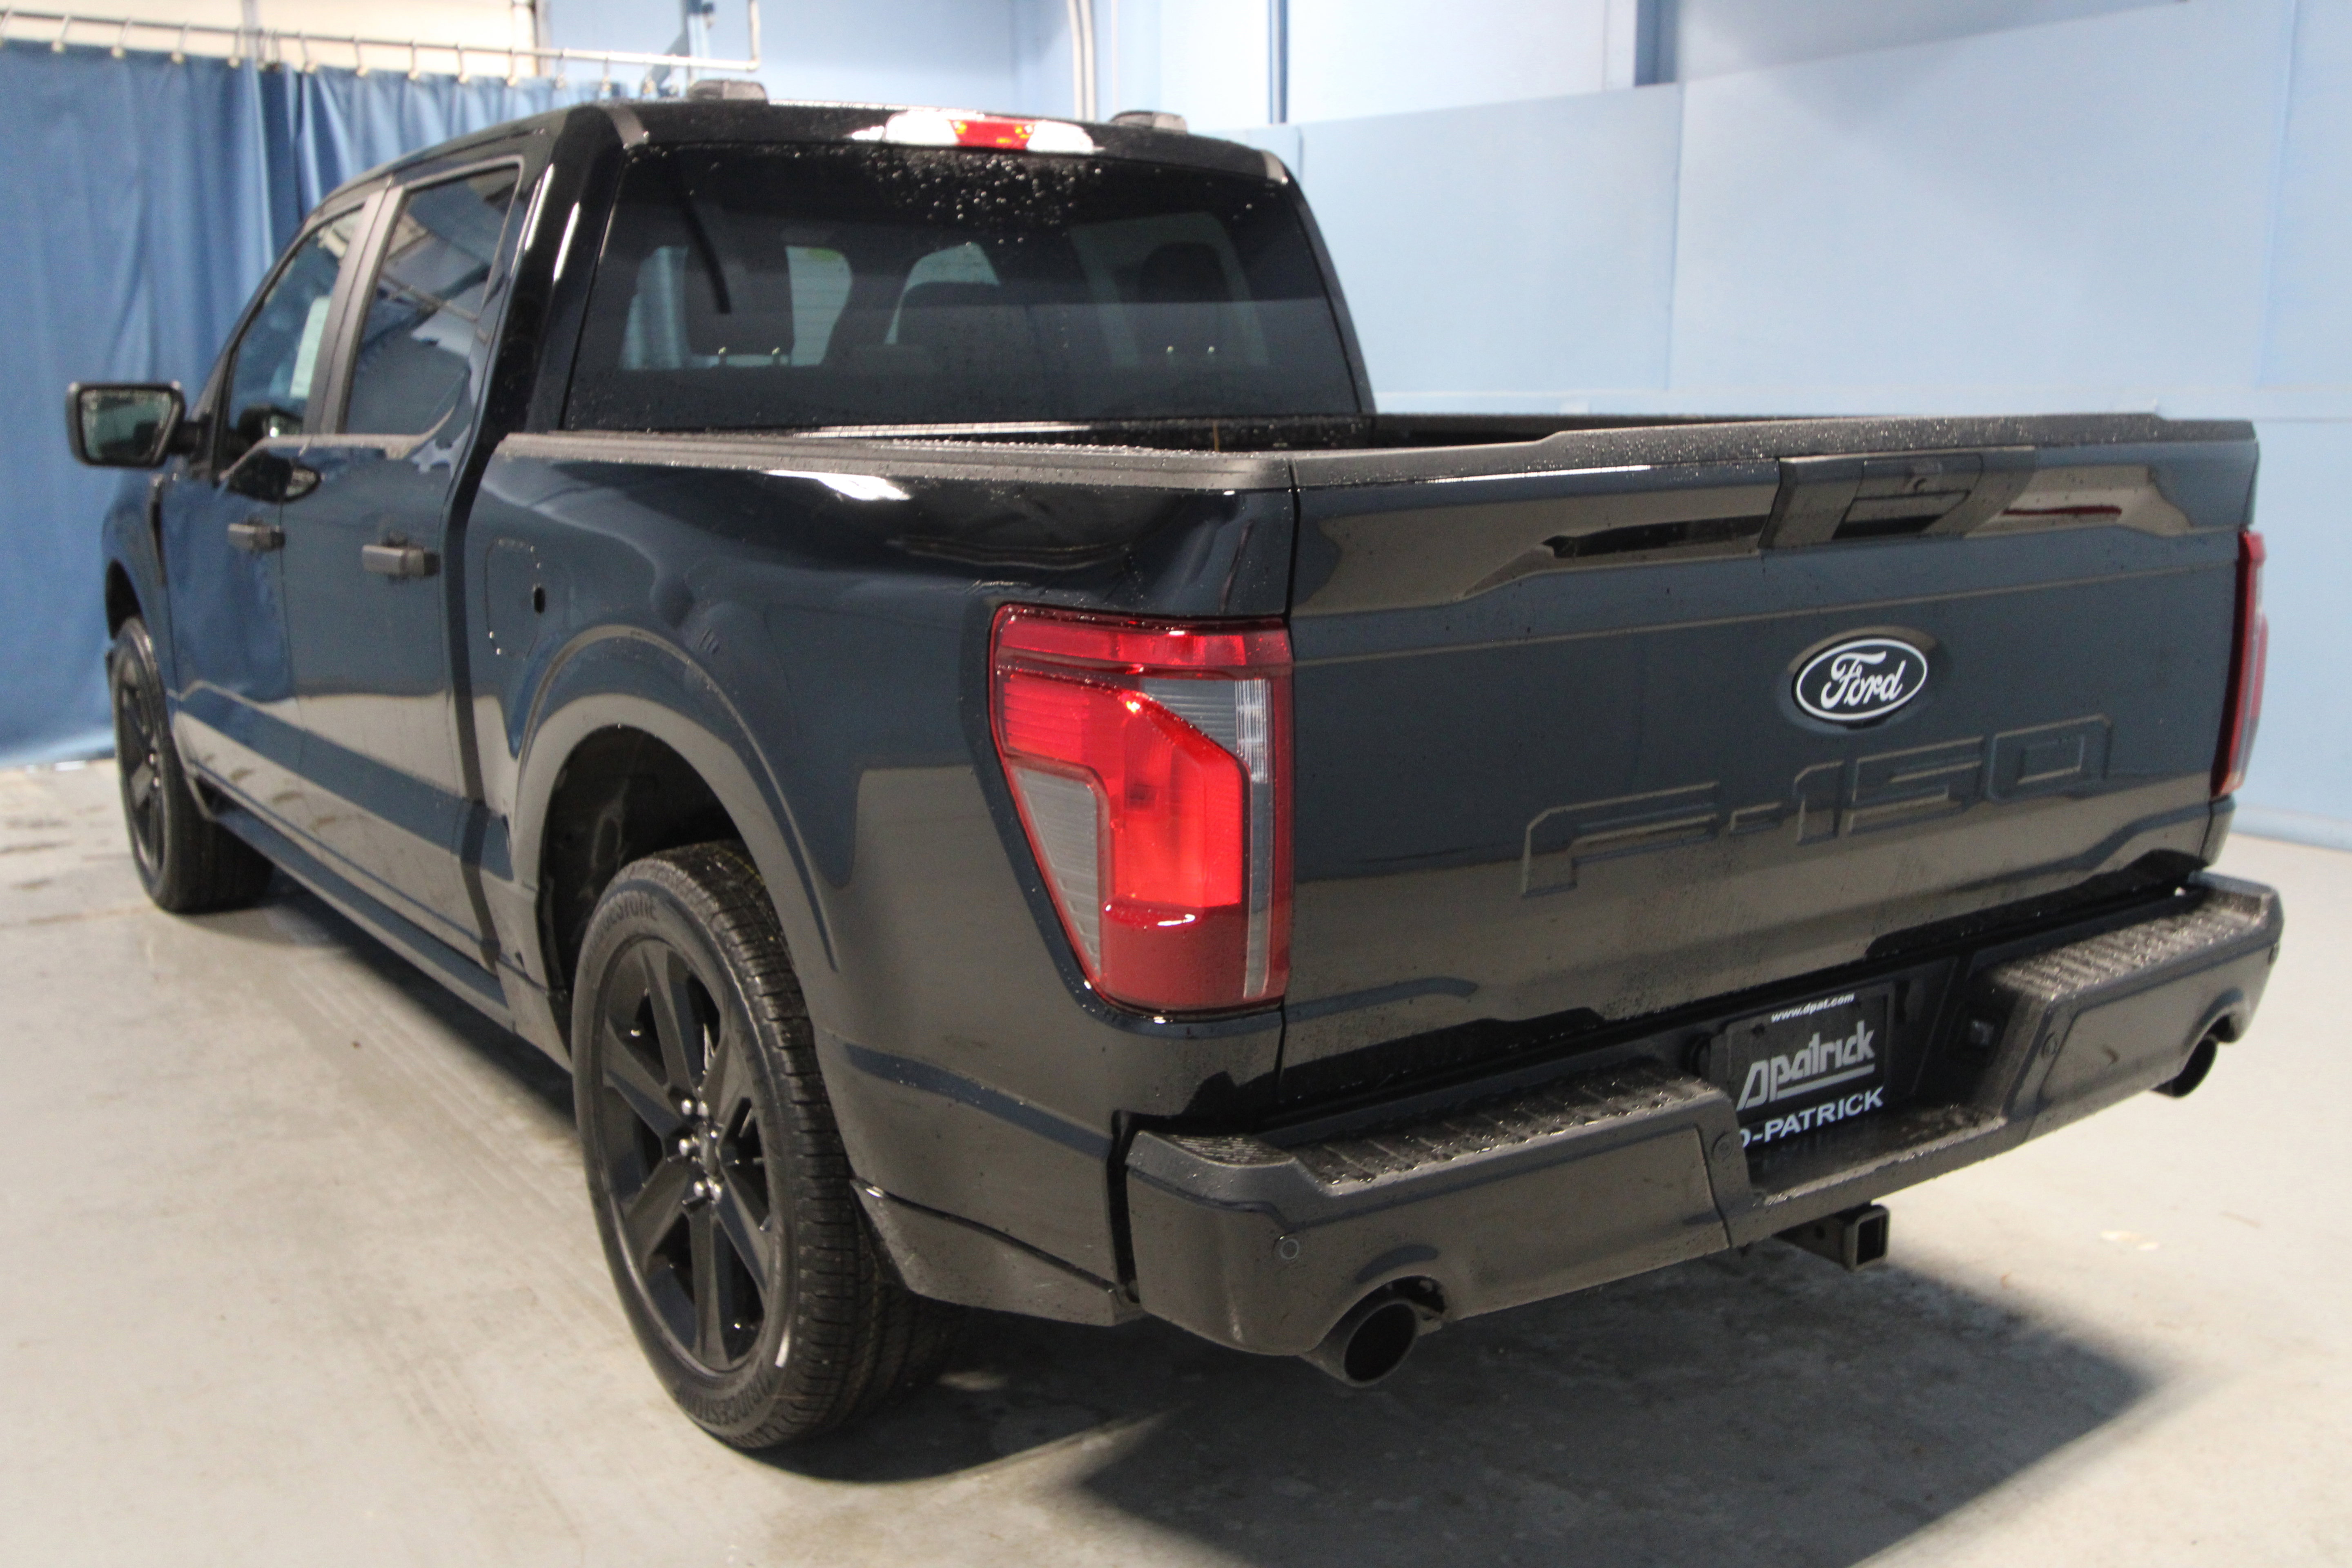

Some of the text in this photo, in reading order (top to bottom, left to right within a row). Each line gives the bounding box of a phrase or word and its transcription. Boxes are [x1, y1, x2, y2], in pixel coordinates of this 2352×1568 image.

[1821, 651, 1907, 710] Ford
[1521, 714, 2113, 897] F-150
[1771, 993, 1855, 1023] www.dpat.com
